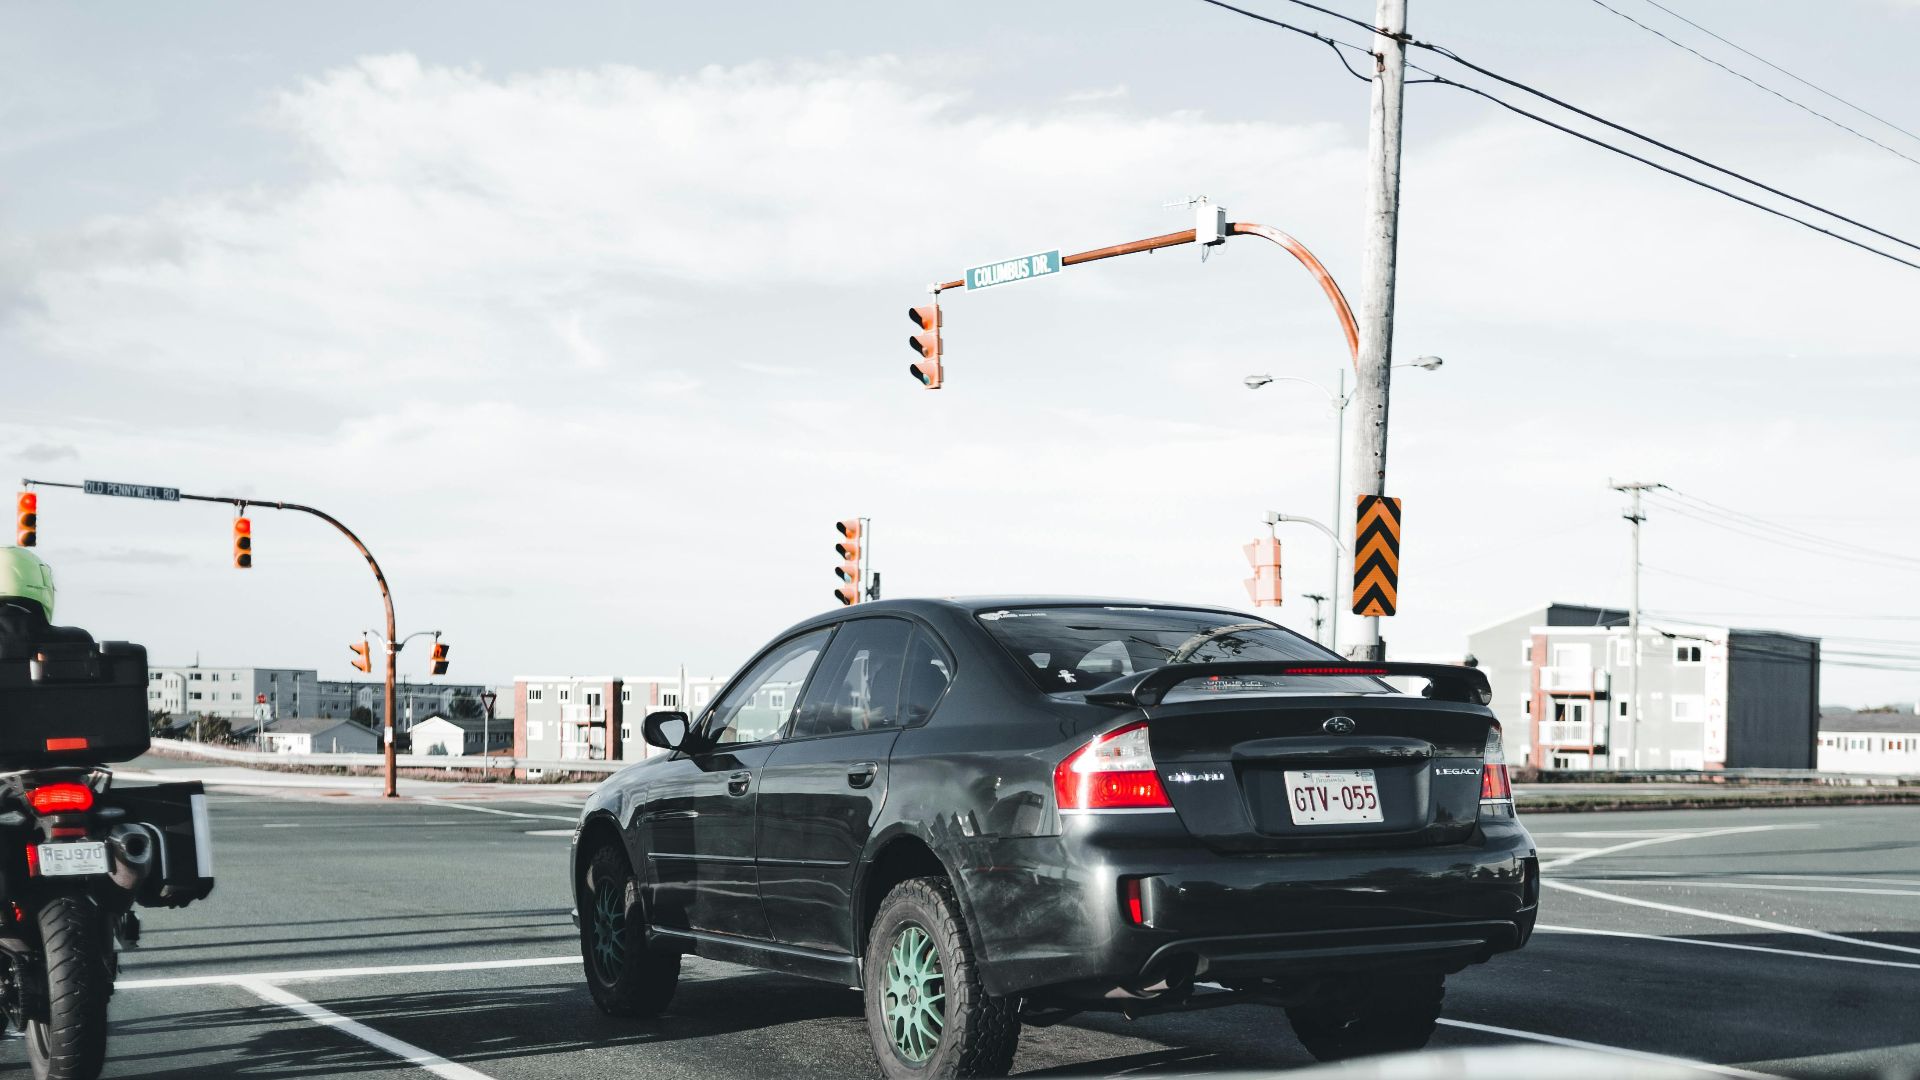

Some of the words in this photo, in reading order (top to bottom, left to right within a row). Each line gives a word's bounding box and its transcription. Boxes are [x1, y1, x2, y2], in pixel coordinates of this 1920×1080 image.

[974, 258, 1030, 288] COLUMBUS
[1031, 254, 1052, 276] DR.
[85, 482, 104, 494] OLD
[107, 483, 160, 500] PENNYWELL
[163, 487, 178, 500] RD.
[1168, 772, 1225, 783] SUBARU
[1435, 768, 1481, 776] LEGACY
[1294, 785, 1377, 812] GTV-055
